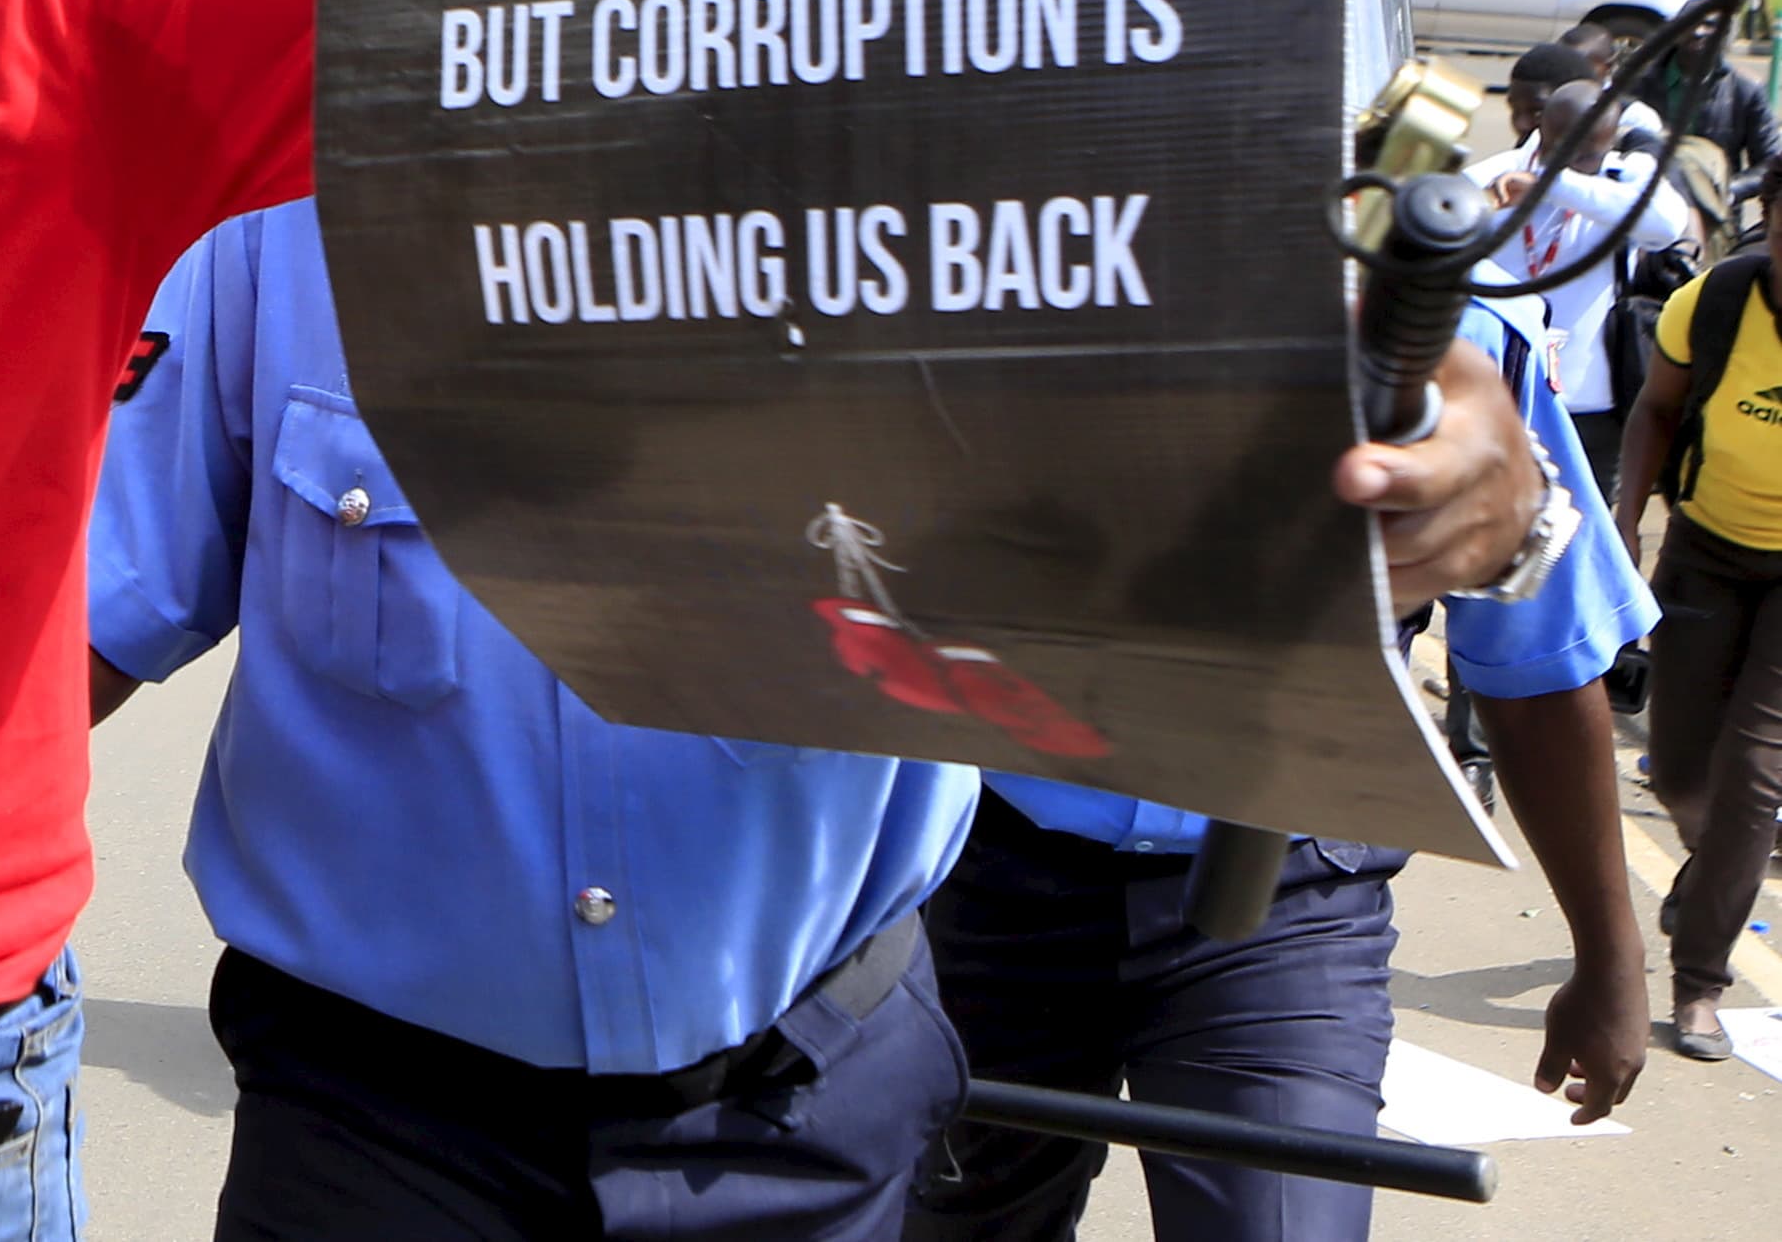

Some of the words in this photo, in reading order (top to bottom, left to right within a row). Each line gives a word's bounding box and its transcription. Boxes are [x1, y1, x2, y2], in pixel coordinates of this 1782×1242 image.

[440, 0, 575, 109] BUT
[473, 210, 787, 324] HOLDING
[806, 204, 908, 316] US
[930, 193, 1152, 312] BACK
